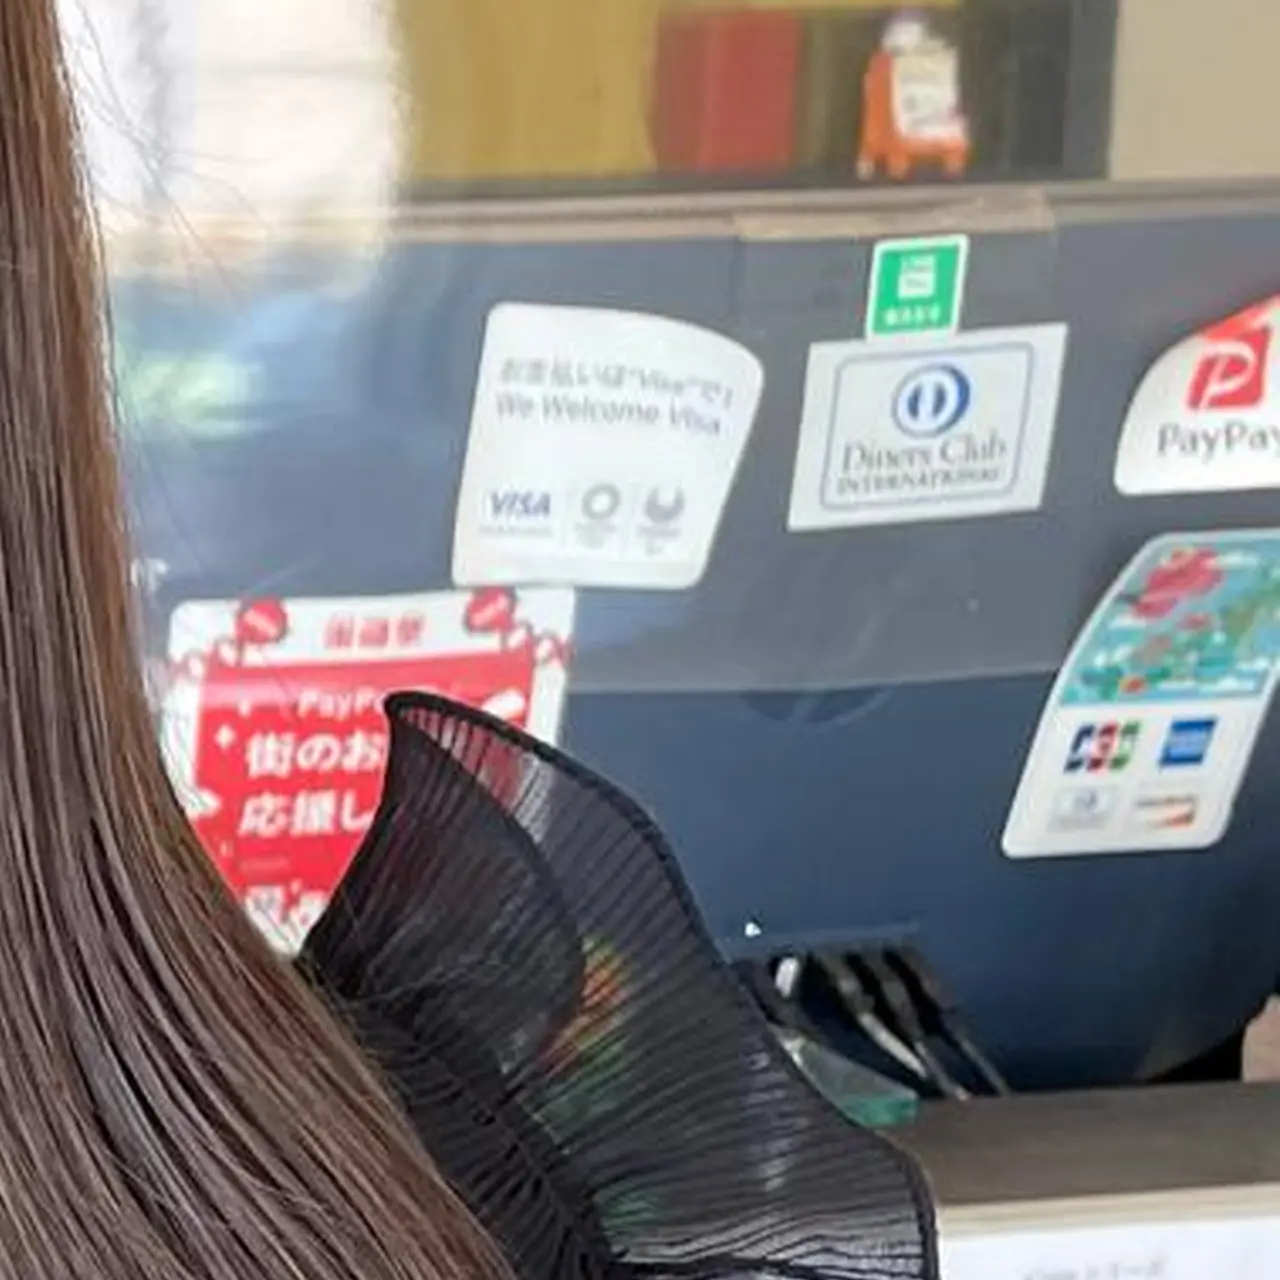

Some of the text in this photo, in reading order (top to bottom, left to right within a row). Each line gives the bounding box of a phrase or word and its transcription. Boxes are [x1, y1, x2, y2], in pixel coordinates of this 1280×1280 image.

[542, 395, 660, 426] Welcome
[842, 429, 1008, 473] Diners Club
[490, 489, 551, 517] VISA
[246, 730, 386, 779] 街のお
